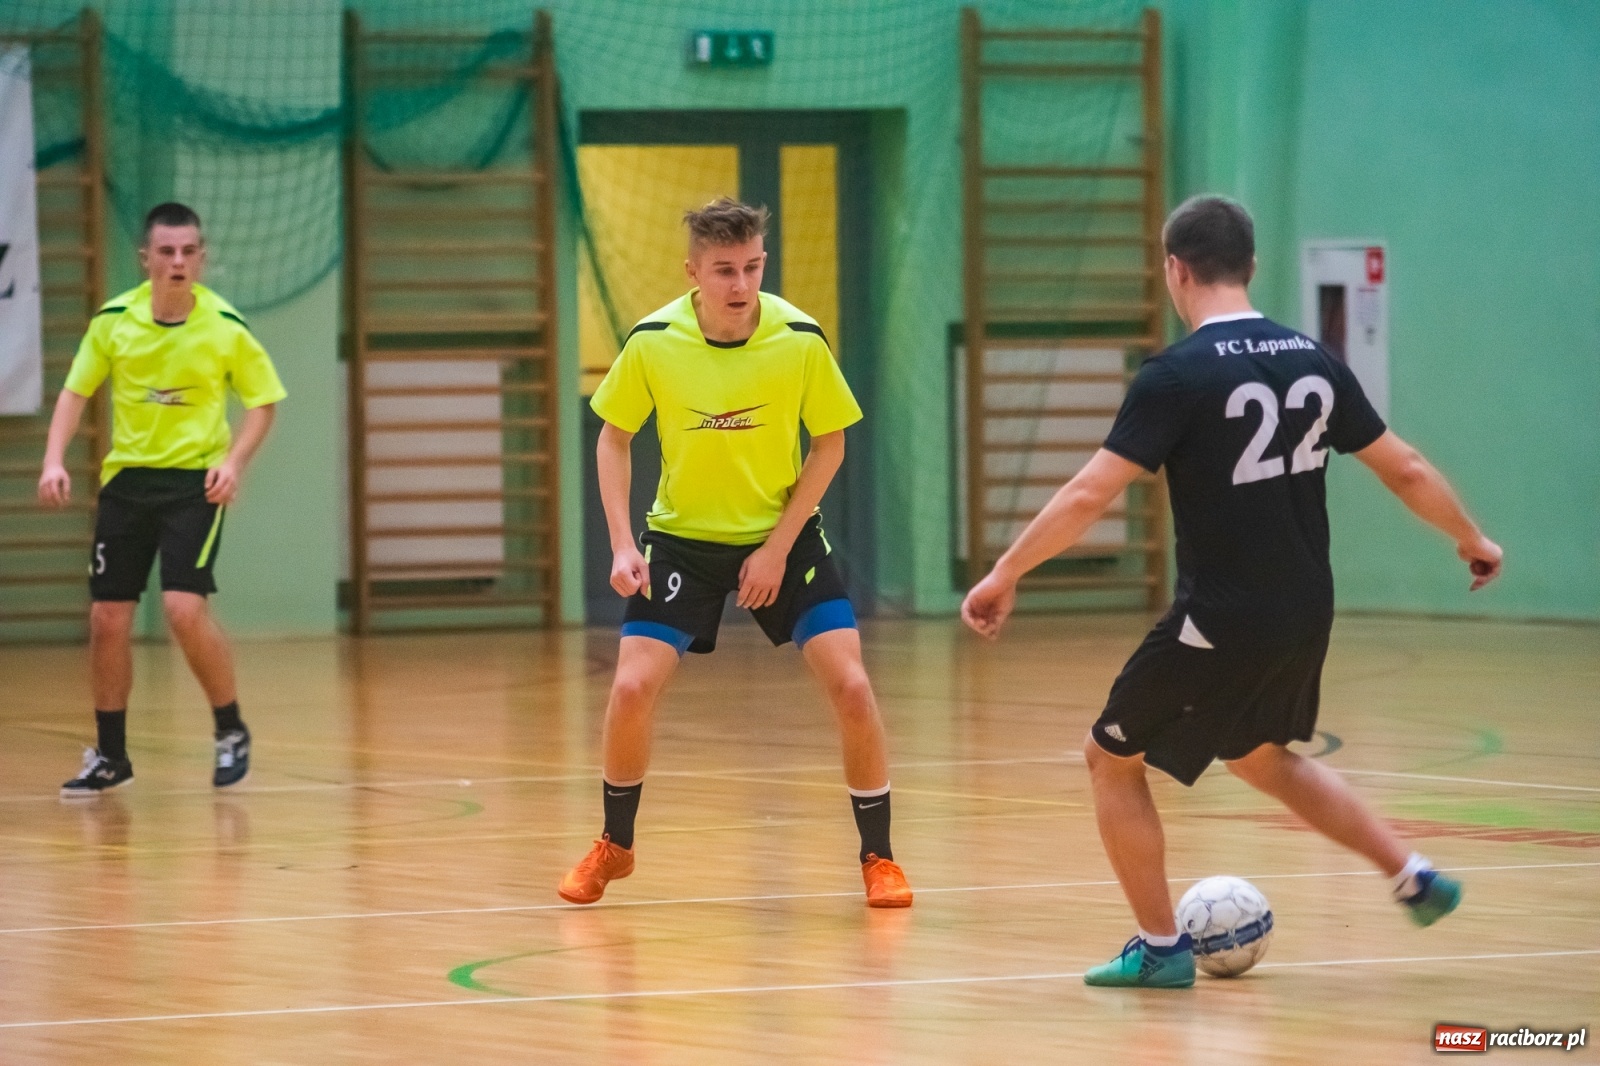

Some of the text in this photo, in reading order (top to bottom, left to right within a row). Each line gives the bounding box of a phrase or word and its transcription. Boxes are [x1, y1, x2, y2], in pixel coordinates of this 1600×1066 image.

[1214, 335, 1316, 356] FC Łapanka
[1225, 374, 1335, 485] 22
[96, 543, 106, 575] 5
[664, 572, 682, 602] 9
